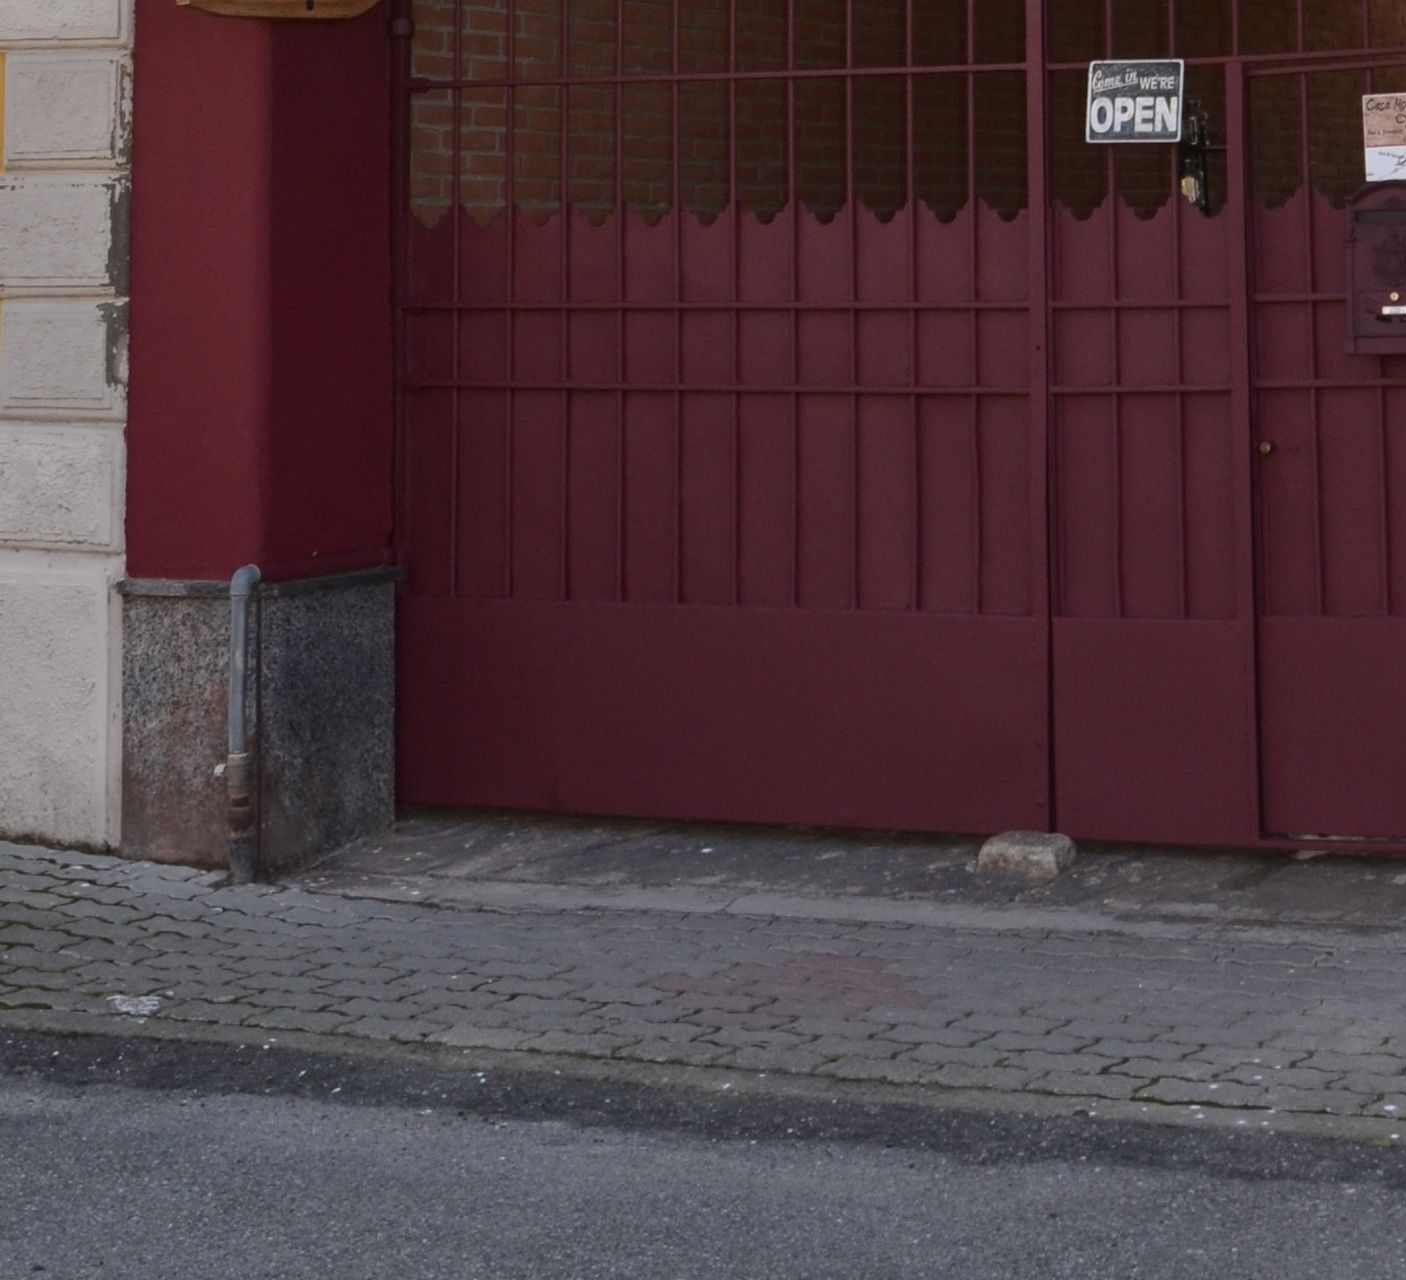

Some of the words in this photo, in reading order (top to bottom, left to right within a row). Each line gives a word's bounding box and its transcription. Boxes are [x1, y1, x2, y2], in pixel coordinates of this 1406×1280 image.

[1092, 70, 1121, 90] Come
[1125, 68, 1138, 83] in
[1140, 75, 1175, 90] WE'RE
[1090, 96, 1178, 133] OPEN
